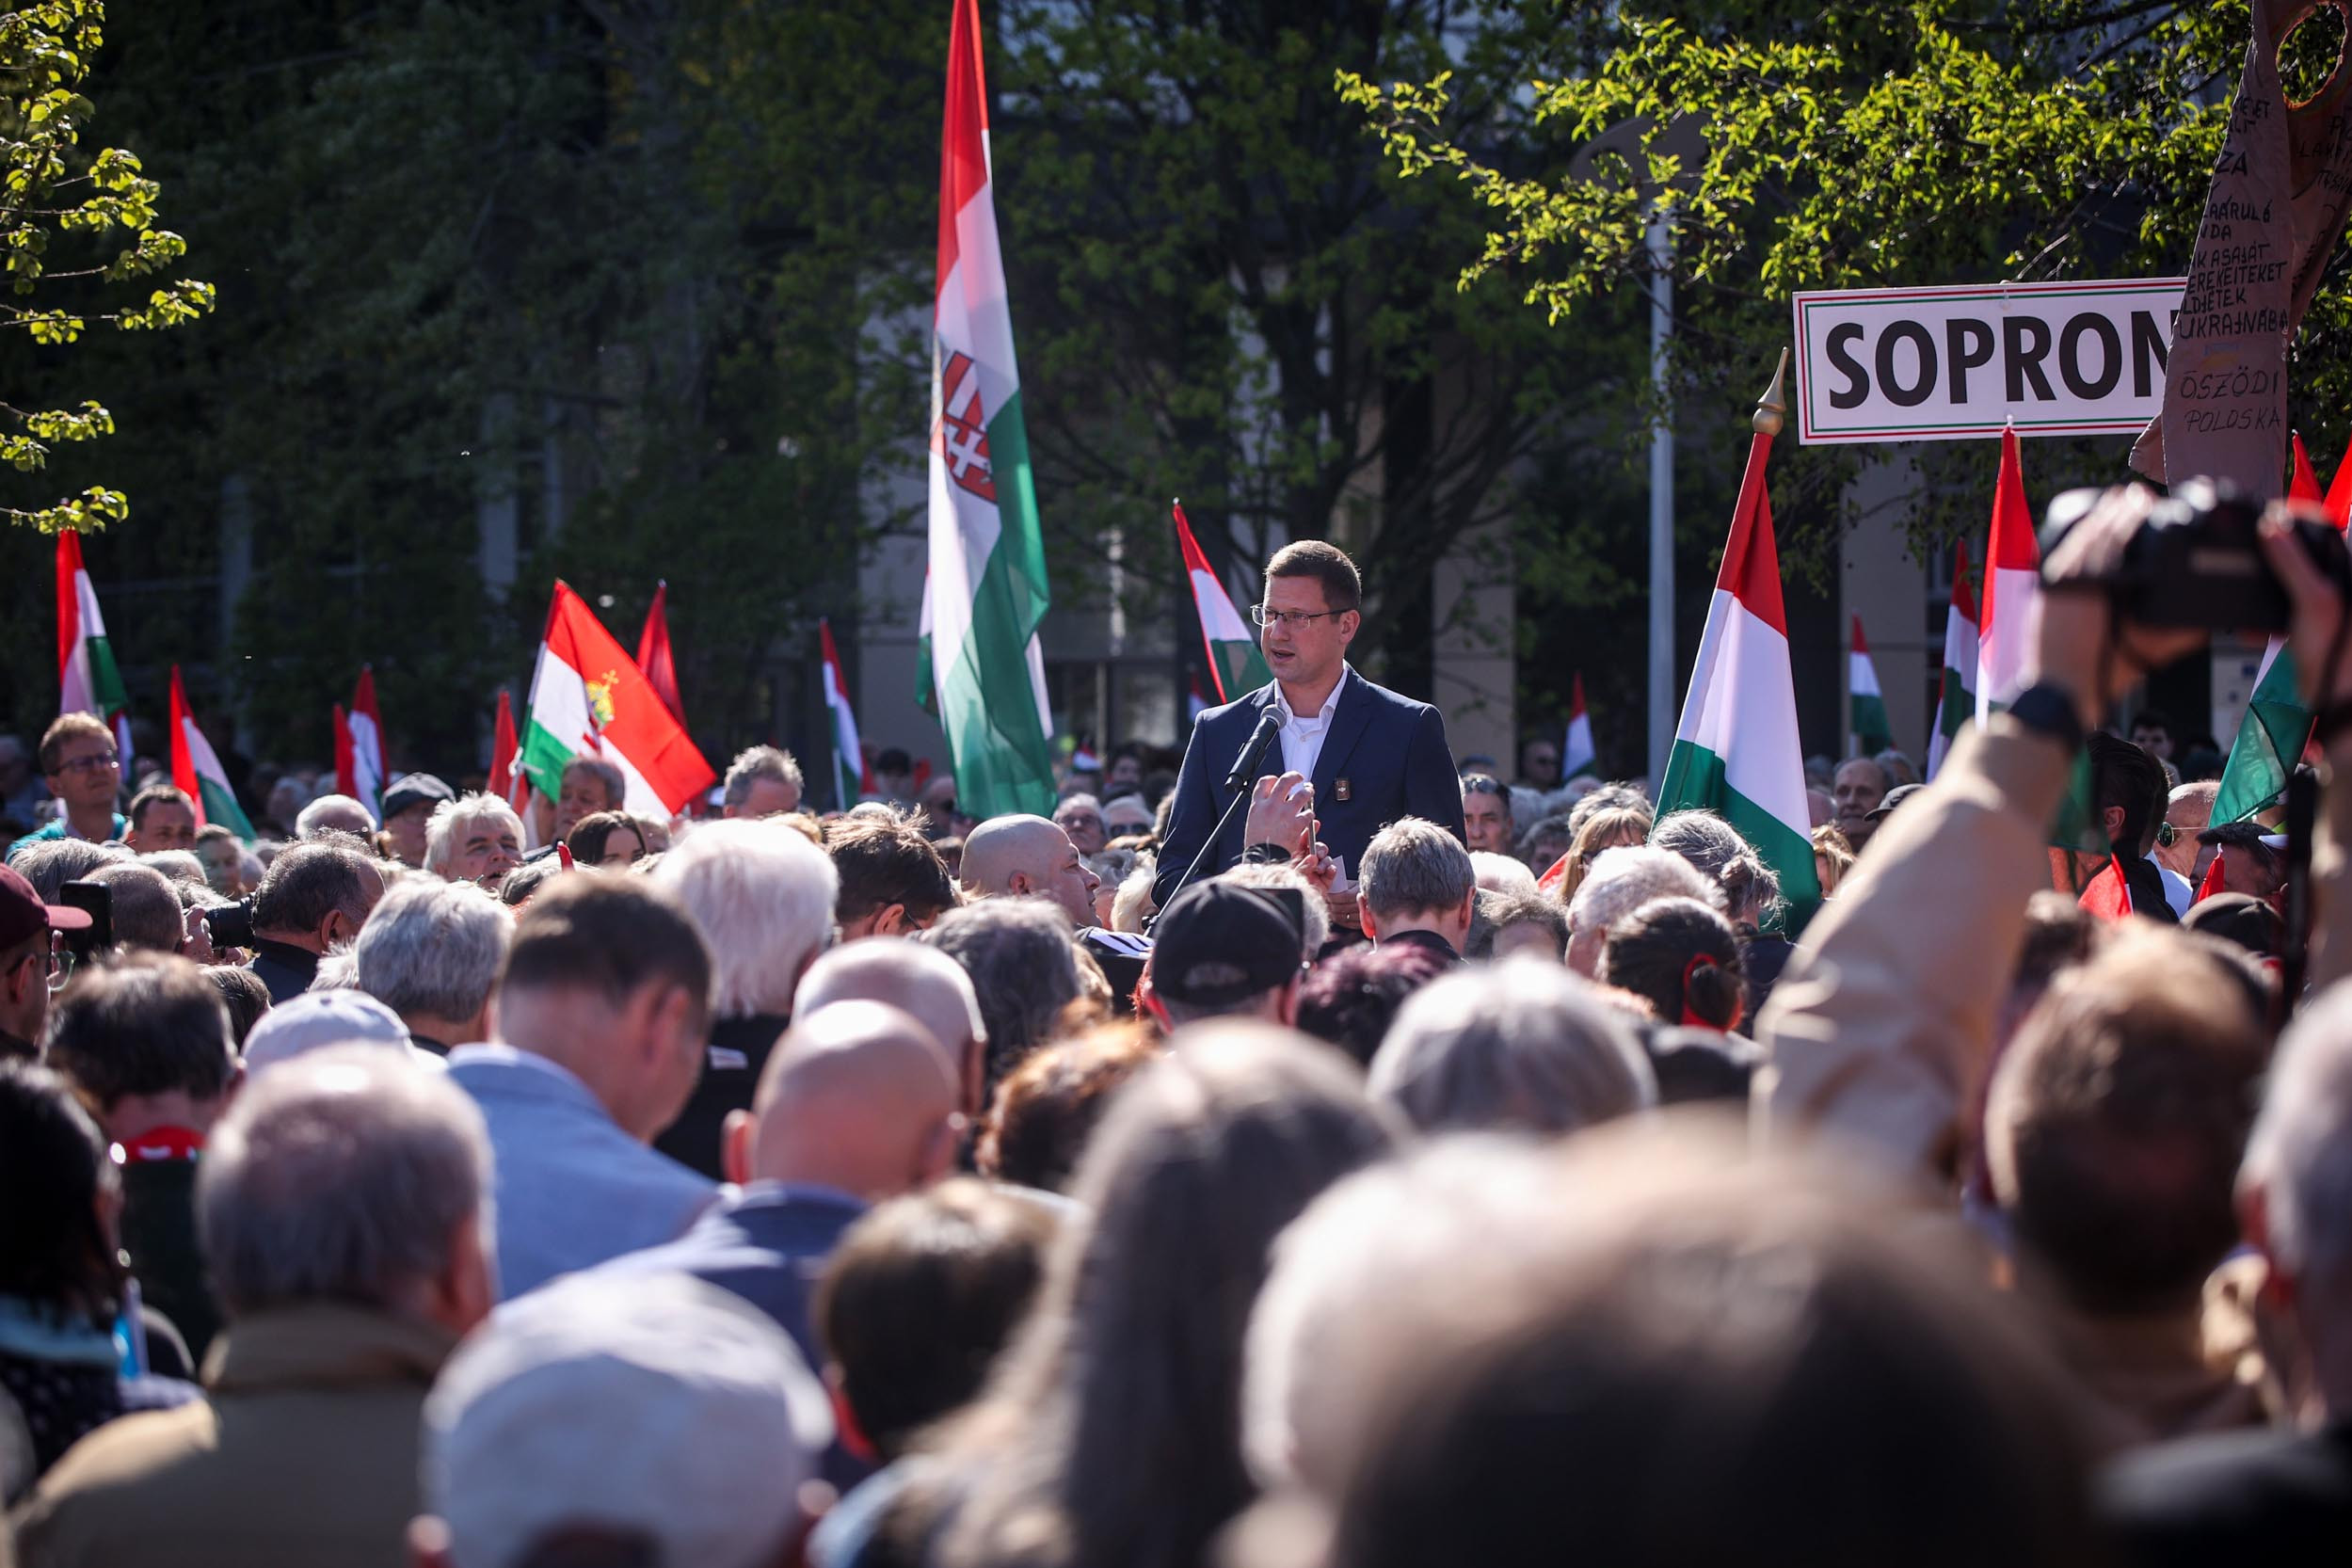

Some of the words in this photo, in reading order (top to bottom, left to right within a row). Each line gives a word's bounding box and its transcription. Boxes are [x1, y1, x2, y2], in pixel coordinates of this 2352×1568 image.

[2203, 195, 2274, 224] AÁRULÓ
[1825, 311, 2181, 409] SOPRON
[2184, 406, 2281, 433] POLOSKA
